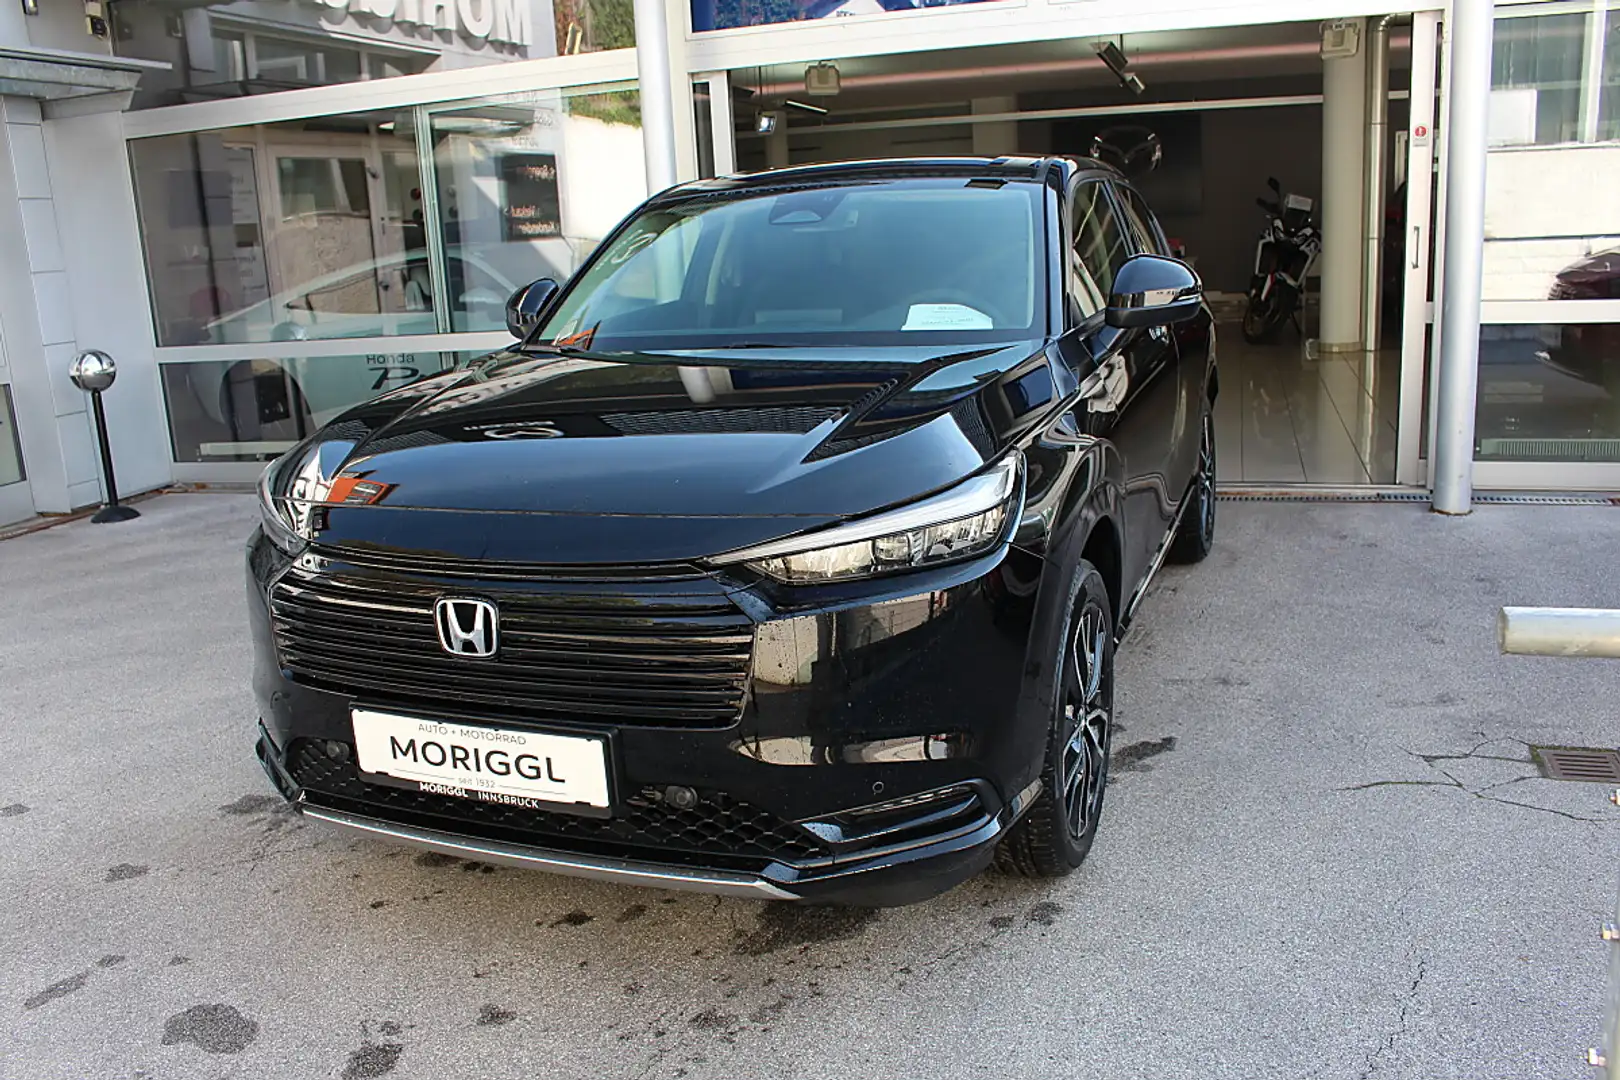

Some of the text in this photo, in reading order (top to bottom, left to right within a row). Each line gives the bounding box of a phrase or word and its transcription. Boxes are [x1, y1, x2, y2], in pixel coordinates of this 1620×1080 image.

[366, 353, 415, 364] Honda
[418, 723, 448, 735] AUTO
[460, 728, 527, 745] MOTORRAD
[389, 735, 566, 784] MORIGGL
[475, 776, 496, 789] 1932
[419, 781, 539, 809] MORIGGL INNSBRUCK
